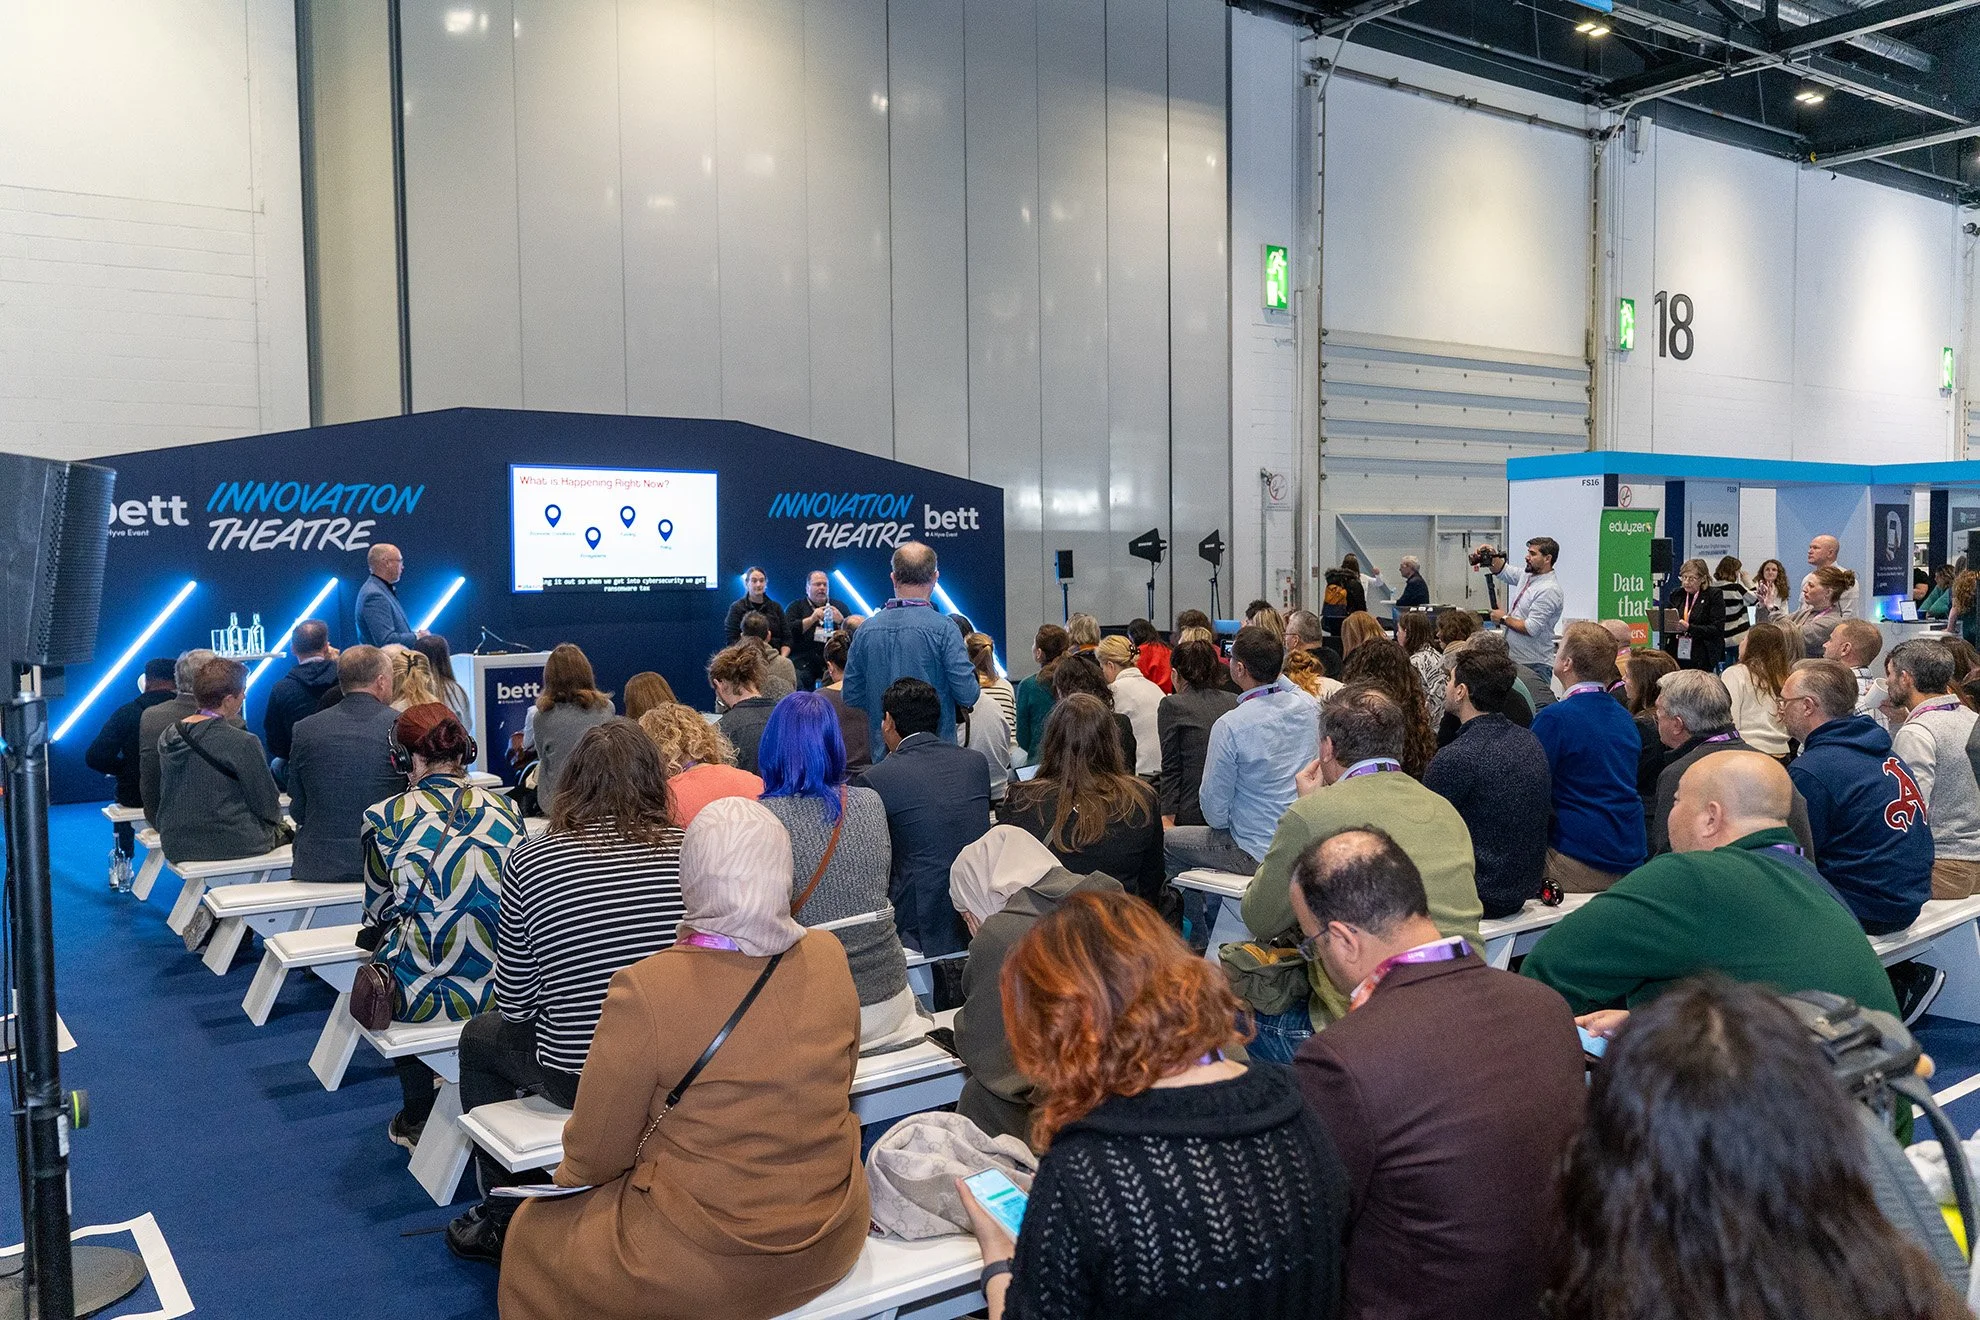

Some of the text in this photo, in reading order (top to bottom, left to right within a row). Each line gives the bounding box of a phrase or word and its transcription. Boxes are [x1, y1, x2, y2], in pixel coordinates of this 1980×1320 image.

[1654, 290, 1694, 361] 18
[520, 476, 670, 490] What is Happening Right Now?
[1582, 478, 1600, 486] FS16
[206, 480, 425, 515] INNOVATION
[768, 492, 914, 519] INNOVATION
[924, 504, 980, 530] bett
[127, 529, 149, 537] Event
[207, 517, 376, 551] THEATRE
[805, 521, 915, 550] THEATRE
[1609, 520, 1646, 535] edulyzer
[1697, 520, 1729, 537] twee
[554, 578, 562, 586] it
[587, 577, 602, 585] when
[613, 577, 625, 586] get
[626, 577, 641, 585] into
[642, 576, 684, 586] cybersecurity
[694, 576, 706, 584] get
[1613, 573, 1644, 592] Data
[1618, 595, 1650, 617] that
[497, 682, 540, 699] bett
